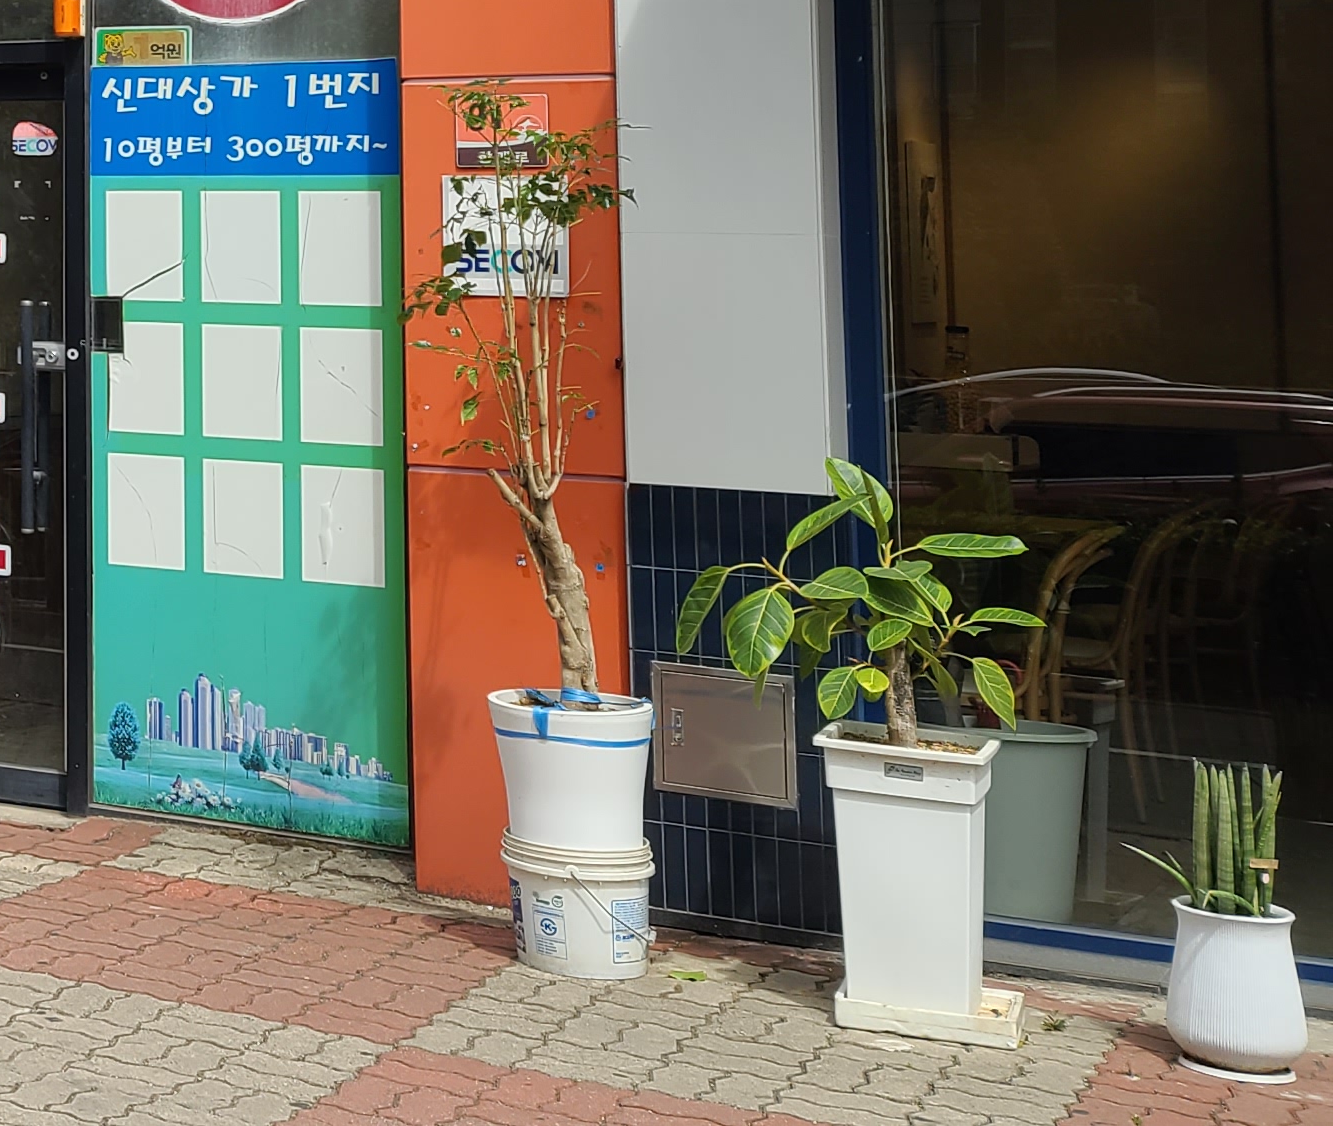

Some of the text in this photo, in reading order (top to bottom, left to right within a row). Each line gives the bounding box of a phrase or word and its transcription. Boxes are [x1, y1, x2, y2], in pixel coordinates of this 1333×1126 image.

[101, 74, 259, 115] 신대상가
[103, 134, 388, 166] 10평부터 300평까지~
